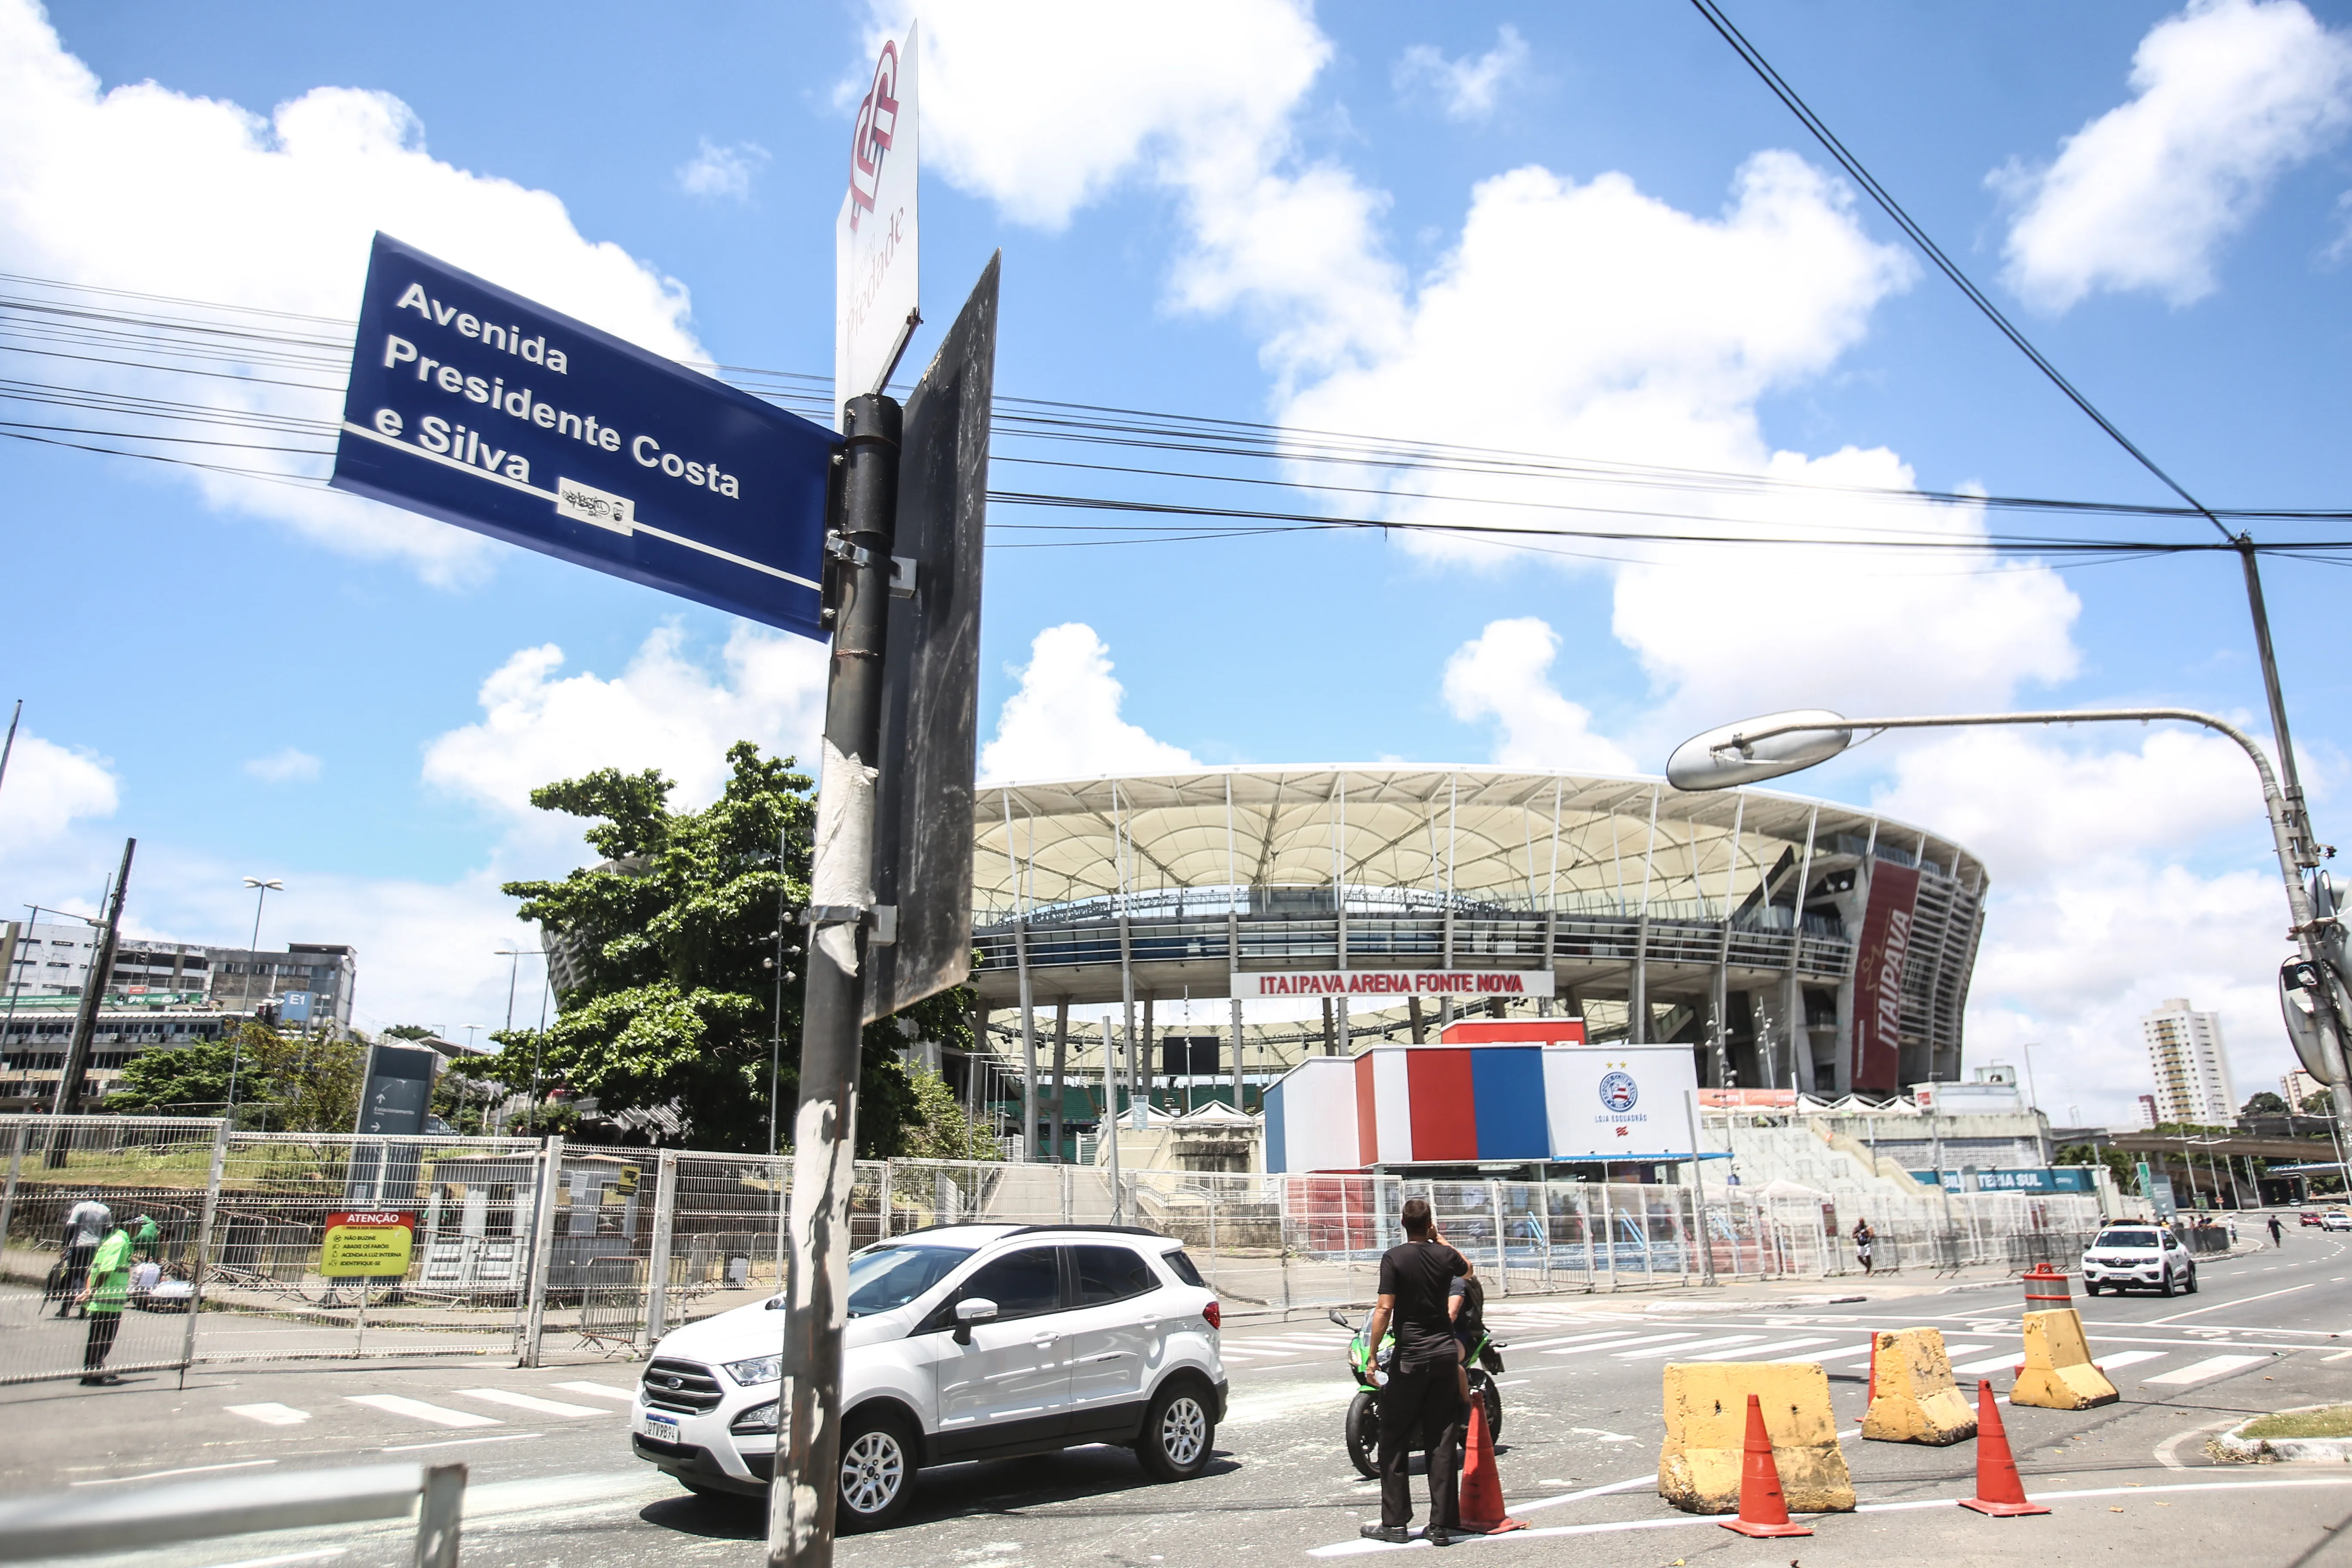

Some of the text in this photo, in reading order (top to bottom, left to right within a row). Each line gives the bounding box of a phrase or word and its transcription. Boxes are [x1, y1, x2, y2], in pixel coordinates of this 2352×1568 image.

[846, 206, 904, 358] Piedade
[396, 283, 568, 375] Avenida
[383, 334, 740, 500] Presidente Costa
[374, 408, 530, 484] e Silva
[1260, 974, 1524, 994] ITAIPAVA ARENA FONTE NOVA
[1877, 908, 1911, 1049] ITAIPAVA
[290, 994, 305, 1005] E1
[374, 1106, 415, 1115] Estacionamento
[1612, 1112, 1648, 1122] ESQUADRÃO
[2015, 1173, 2043, 1187] SUL
[347, 1213, 399, 1224] ATENÇÃO
